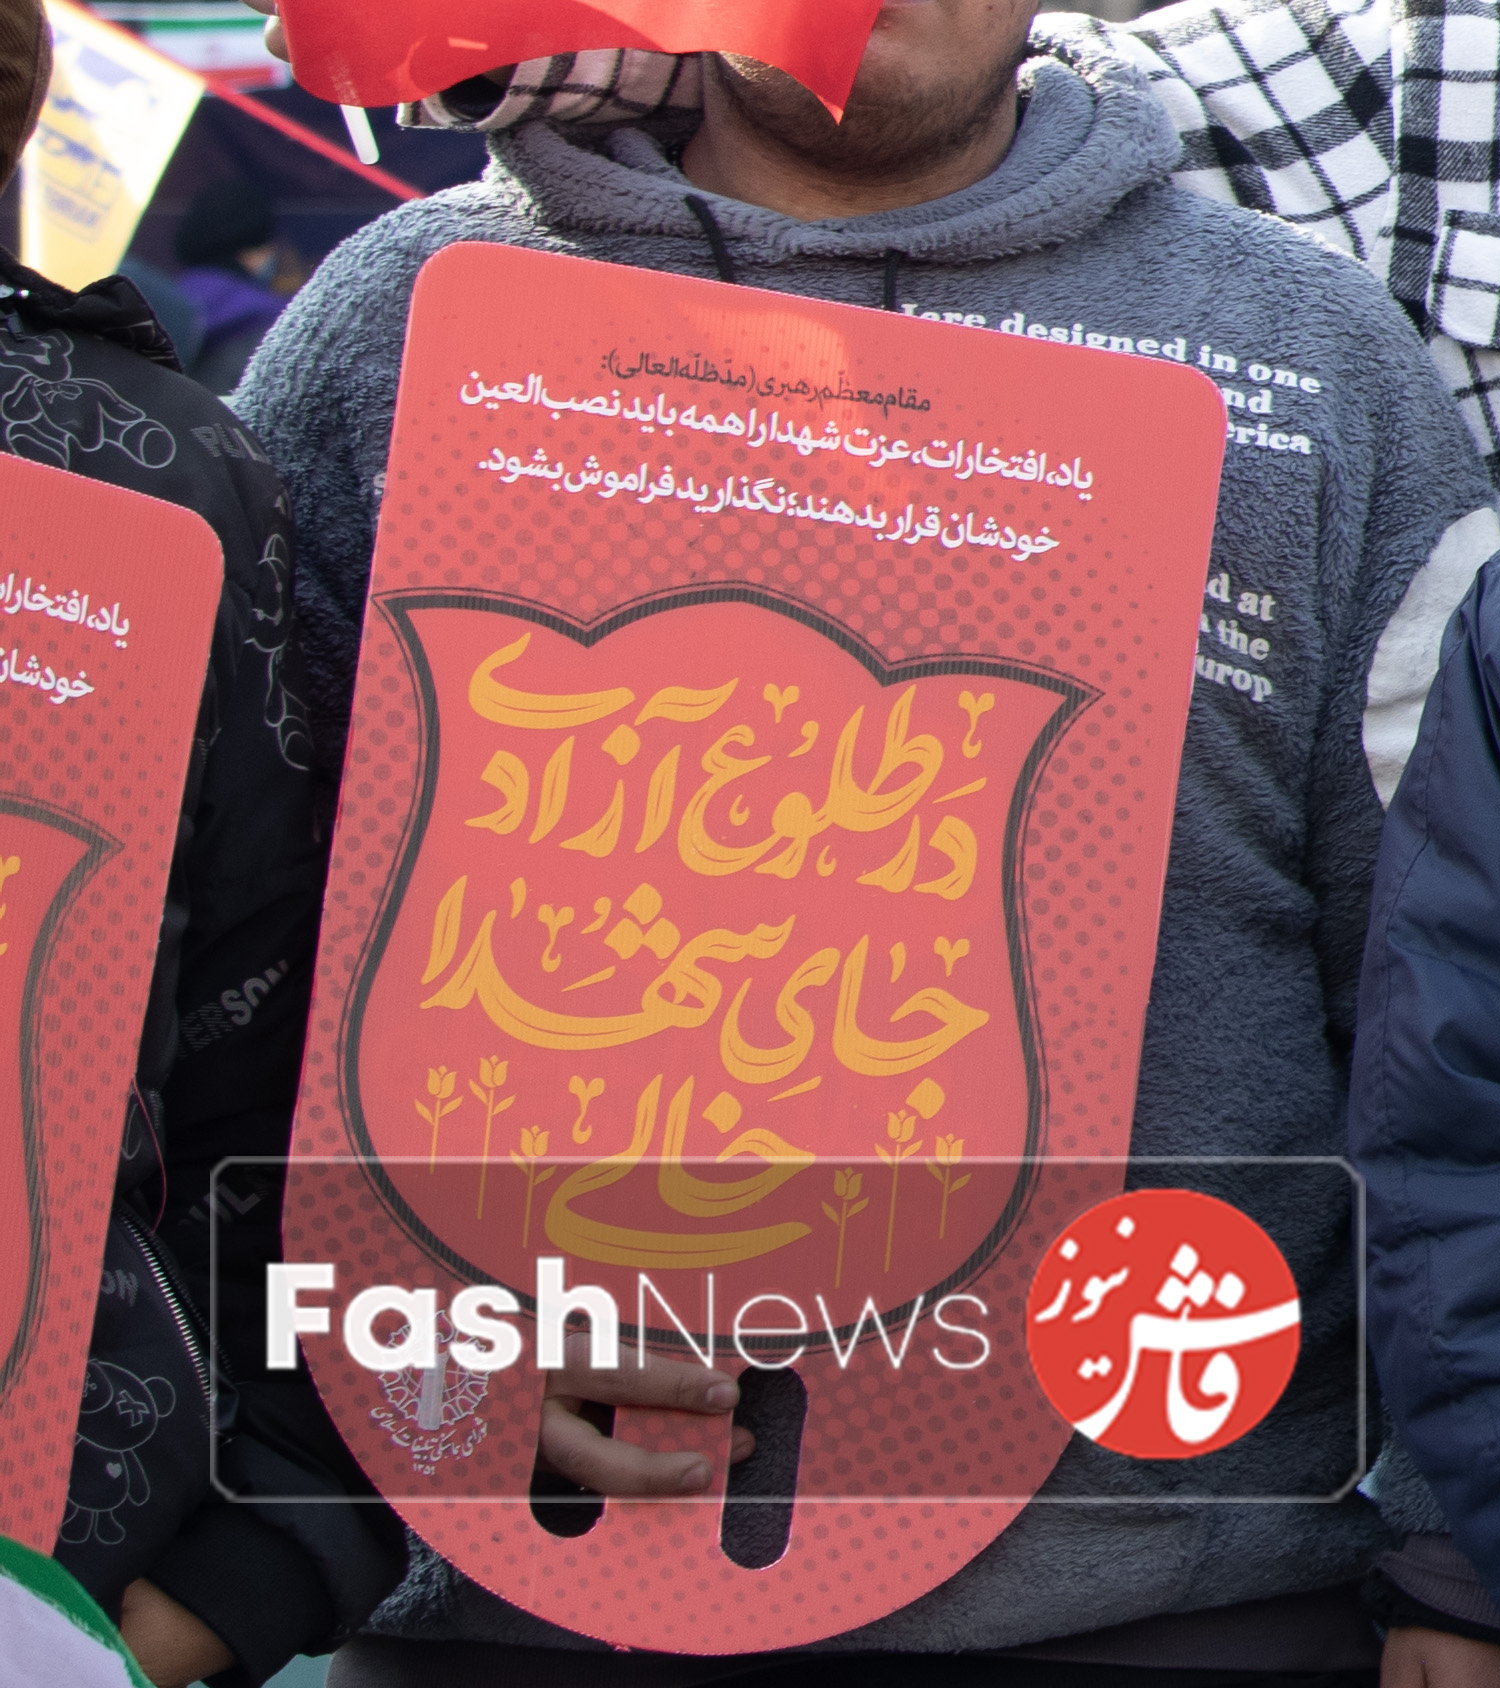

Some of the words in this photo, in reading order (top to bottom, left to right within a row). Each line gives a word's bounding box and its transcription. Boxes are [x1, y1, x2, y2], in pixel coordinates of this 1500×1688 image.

[1000, 312, 1187, 362] designed
[1197, 345, 1239, 373] in
[1248, 364, 1321, 394] one
[756, 372, 821, 403] رهبری
[883, 385, 931, 419] مقام
[1221, 388, 1274, 414] nd
[622, 392, 677, 437] باید
[679, 404, 746, 437] همه
[746, 407, 769, 448] را
[769, 411, 841, 456] شهدا
[843, 427, 913, 468] عزت
[1226, 422, 1312, 455] erica
[563, 454, 676, 504] فراموش
[676, 475, 788, 515] نگذارید
[885, 503, 941, 546] قرار
[940, 511, 1061, 562] خودشان
[1237, 592, 1276, 621] at
[1217, 619, 1271, 661] the
[1195, 654, 1273, 703] urop
[544, 1074, 818, 1271] خالی
